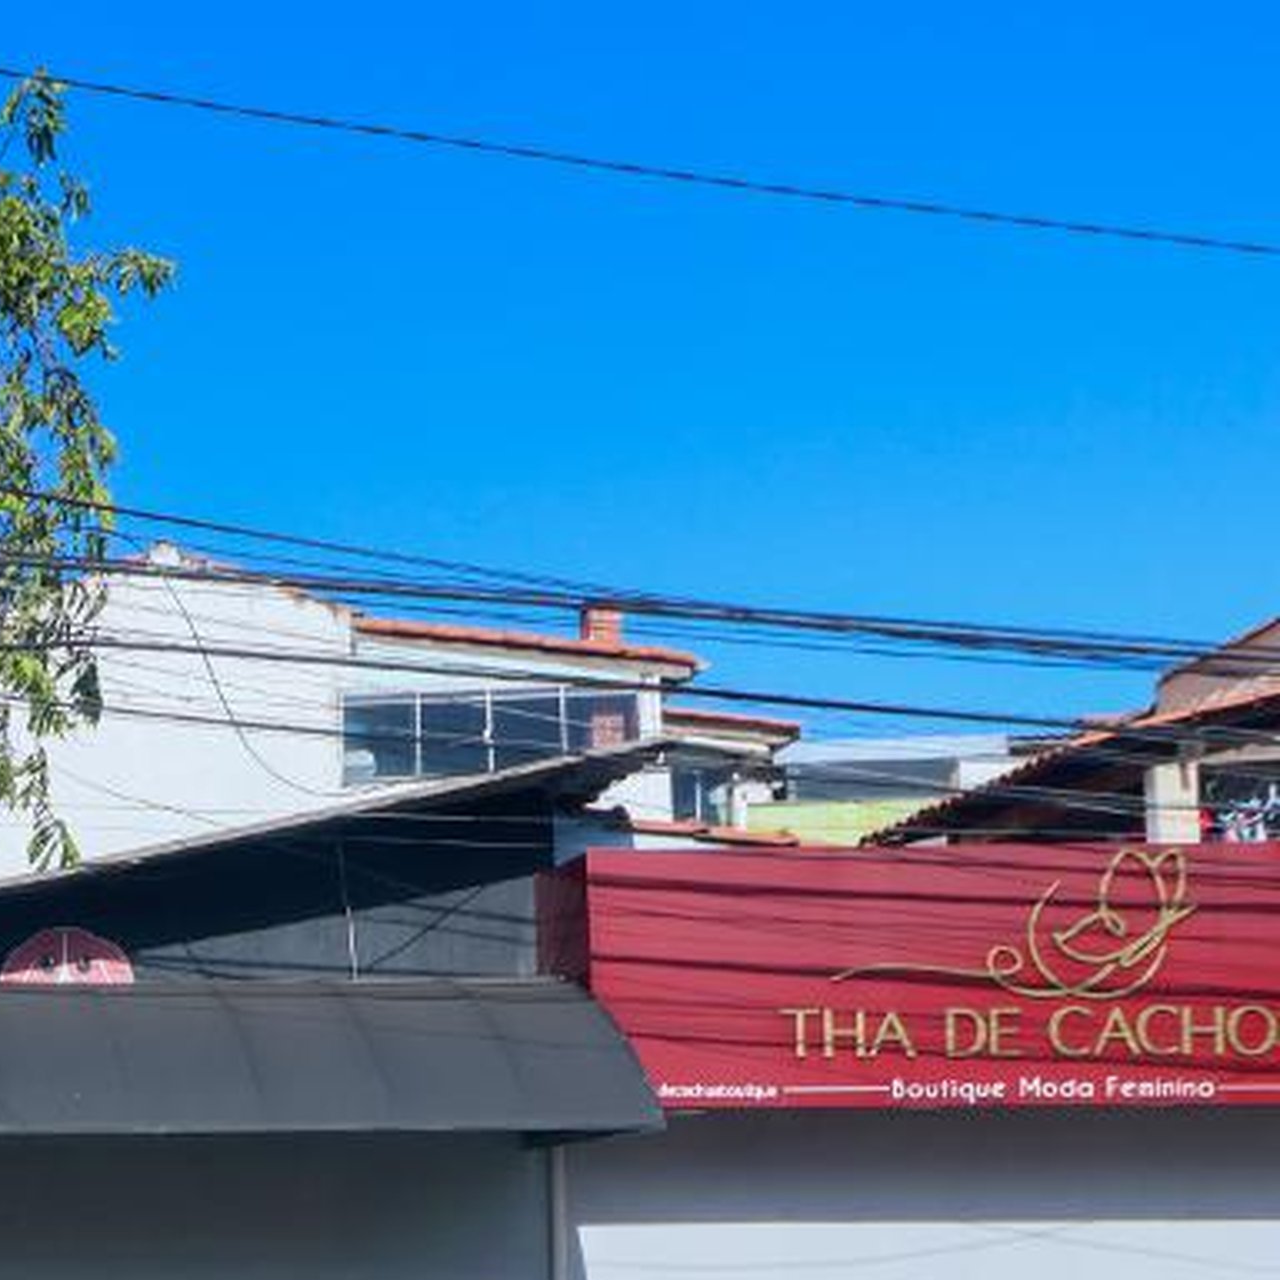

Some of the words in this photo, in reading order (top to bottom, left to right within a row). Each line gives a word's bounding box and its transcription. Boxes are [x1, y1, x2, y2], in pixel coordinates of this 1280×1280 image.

[779, 1005, 917, 1059] THA
[944, 1005, 1021, 1058] DE
[890, 1077, 1006, 1104] Boutique
[1018, 1077, 1095, 1099] Moda
